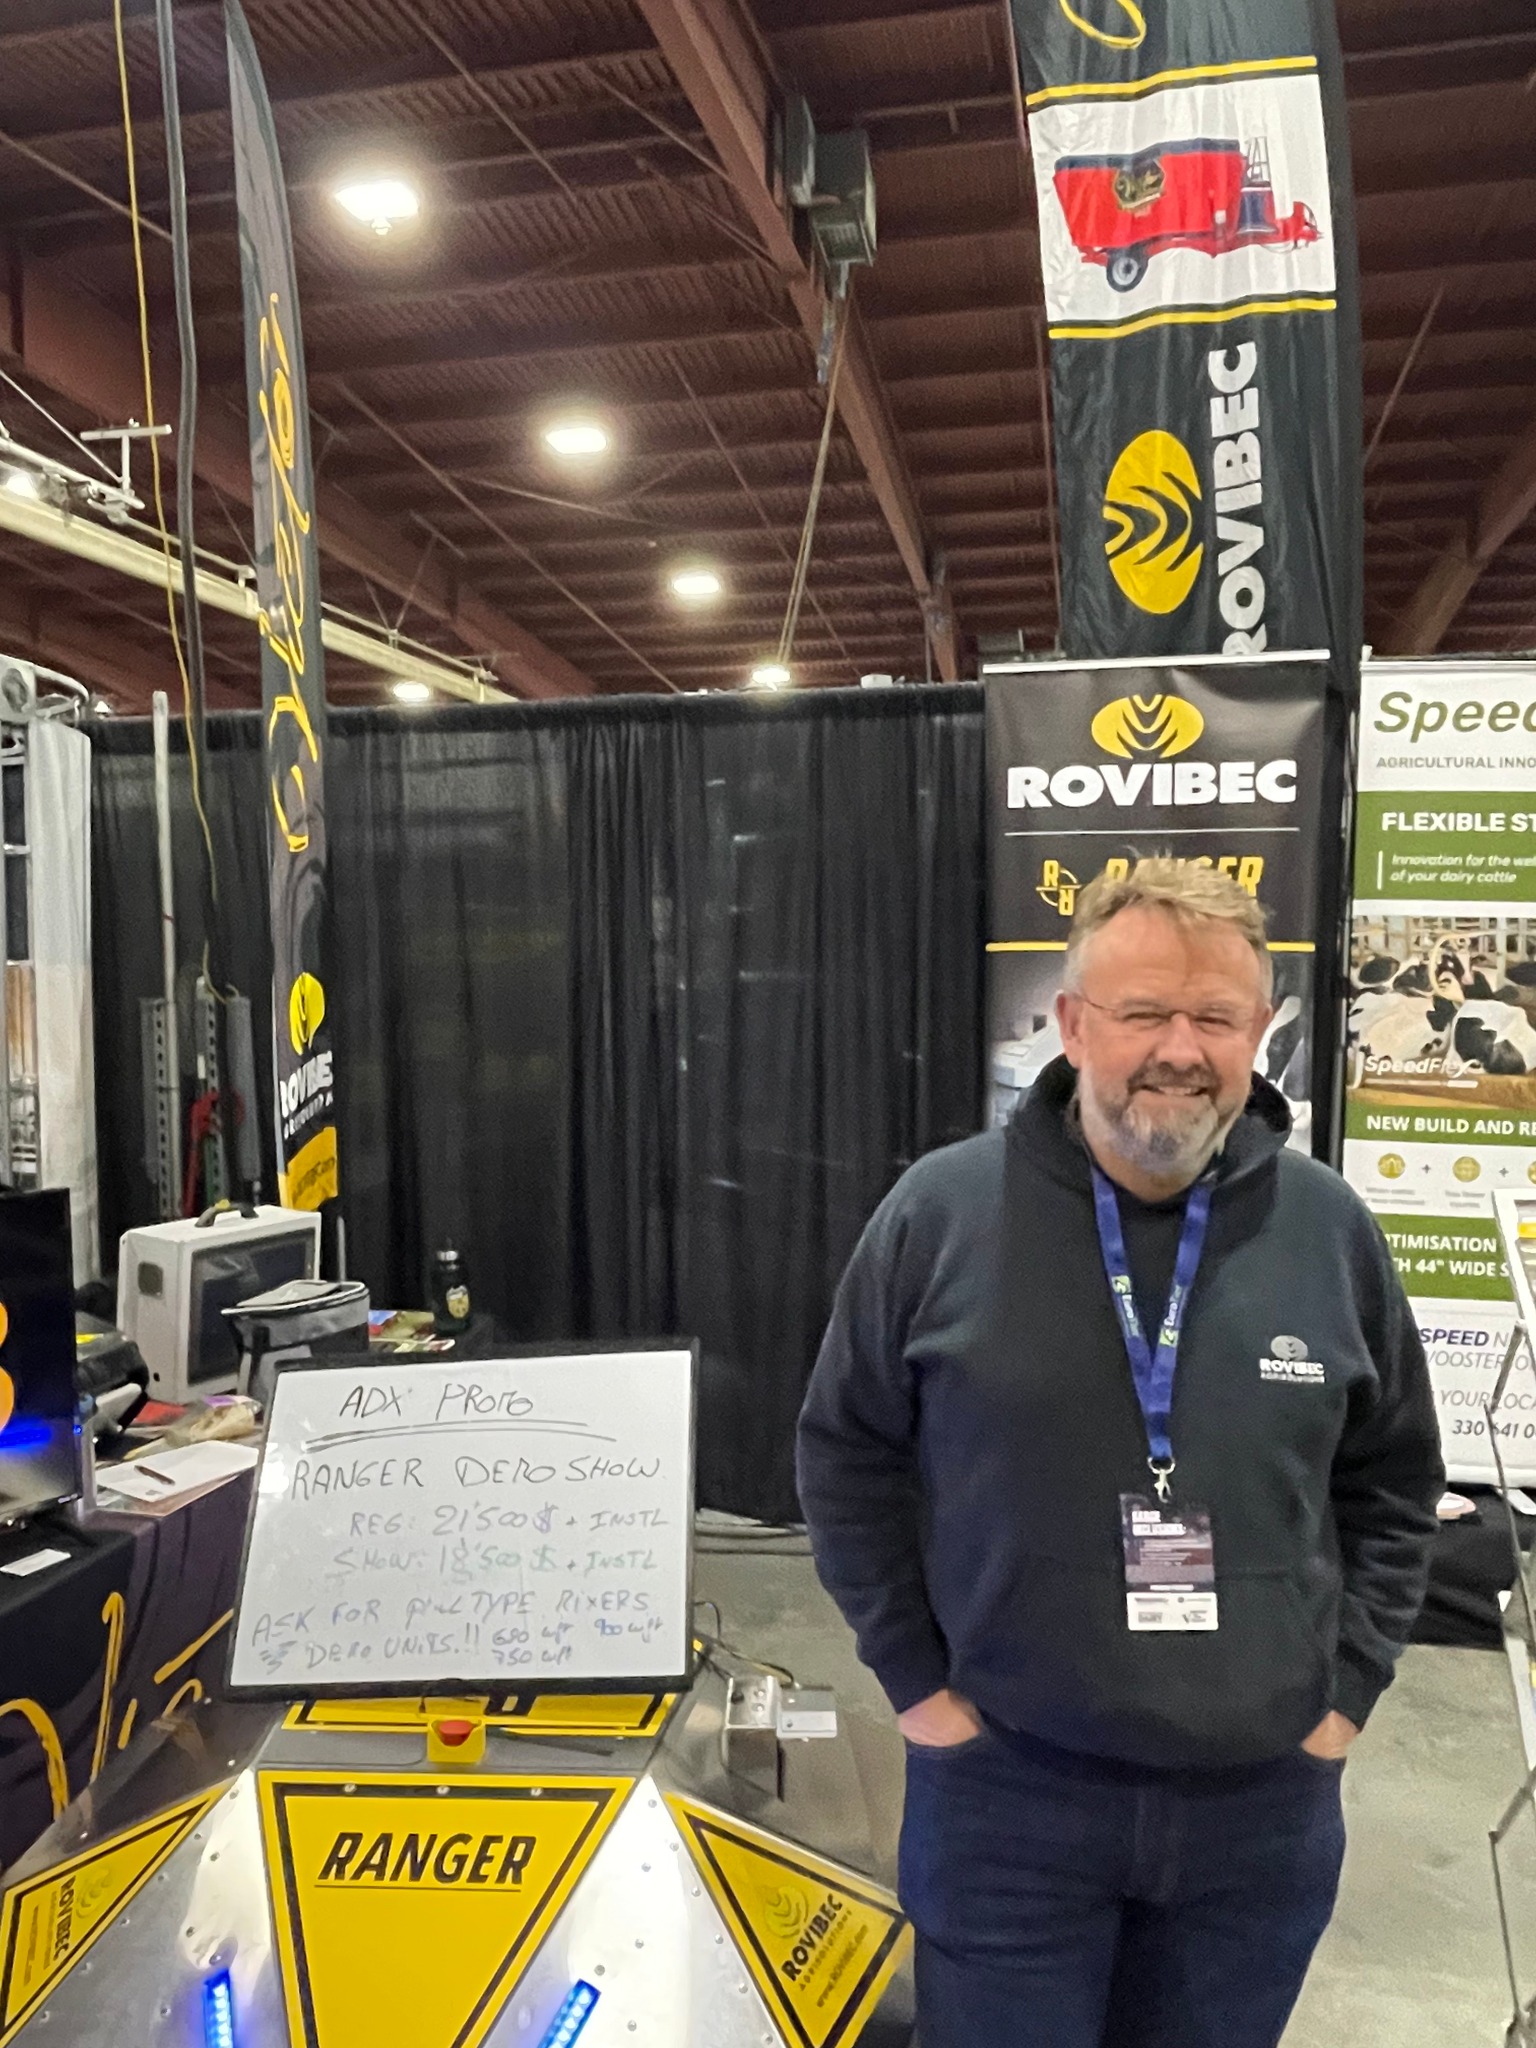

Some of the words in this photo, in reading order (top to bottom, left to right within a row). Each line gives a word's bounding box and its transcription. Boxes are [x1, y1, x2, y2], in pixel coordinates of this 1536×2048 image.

[1376, 757, 1496, 769] AGRICULTURAL
[1007, 759, 1298, 810] ROVIBEC
[1381, 812, 1506, 832] FLEXIBLE
[1392, 853, 1463, 866] Innovation
[1466, 853, 1486, 867] for
[1488, 855, 1511, 867] the
[1390, 869, 1407, 882] of
[1407, 872, 1439, 884] your
[1440, 870, 1475, 884] dairy
[1477, 871, 1517, 883] cattle
[1366, 1115, 1410, 1131] NEW
[1414, 1117, 1470, 1133] BUILD
[1474, 1120, 1515, 1135] AND
[1448, 1260, 1496, 1277] WIDE
[1419, 1327, 1490, 1347] SPEED
[1441, 1389, 1490, 1407] YOUR
[1452, 1419, 1485, 1436] 330
[292, 1458, 424, 1501] RANGER
[565, 1455, 660, 1481] SHOW
[252, 1606, 316, 1647] ASK
[332, 1598, 382, 1626] FOR
[471, 1590, 536, 1623] TYPE
[318, 1831, 537, 1885] RANGER
[781, 1893, 843, 1982] ROVIBEC
